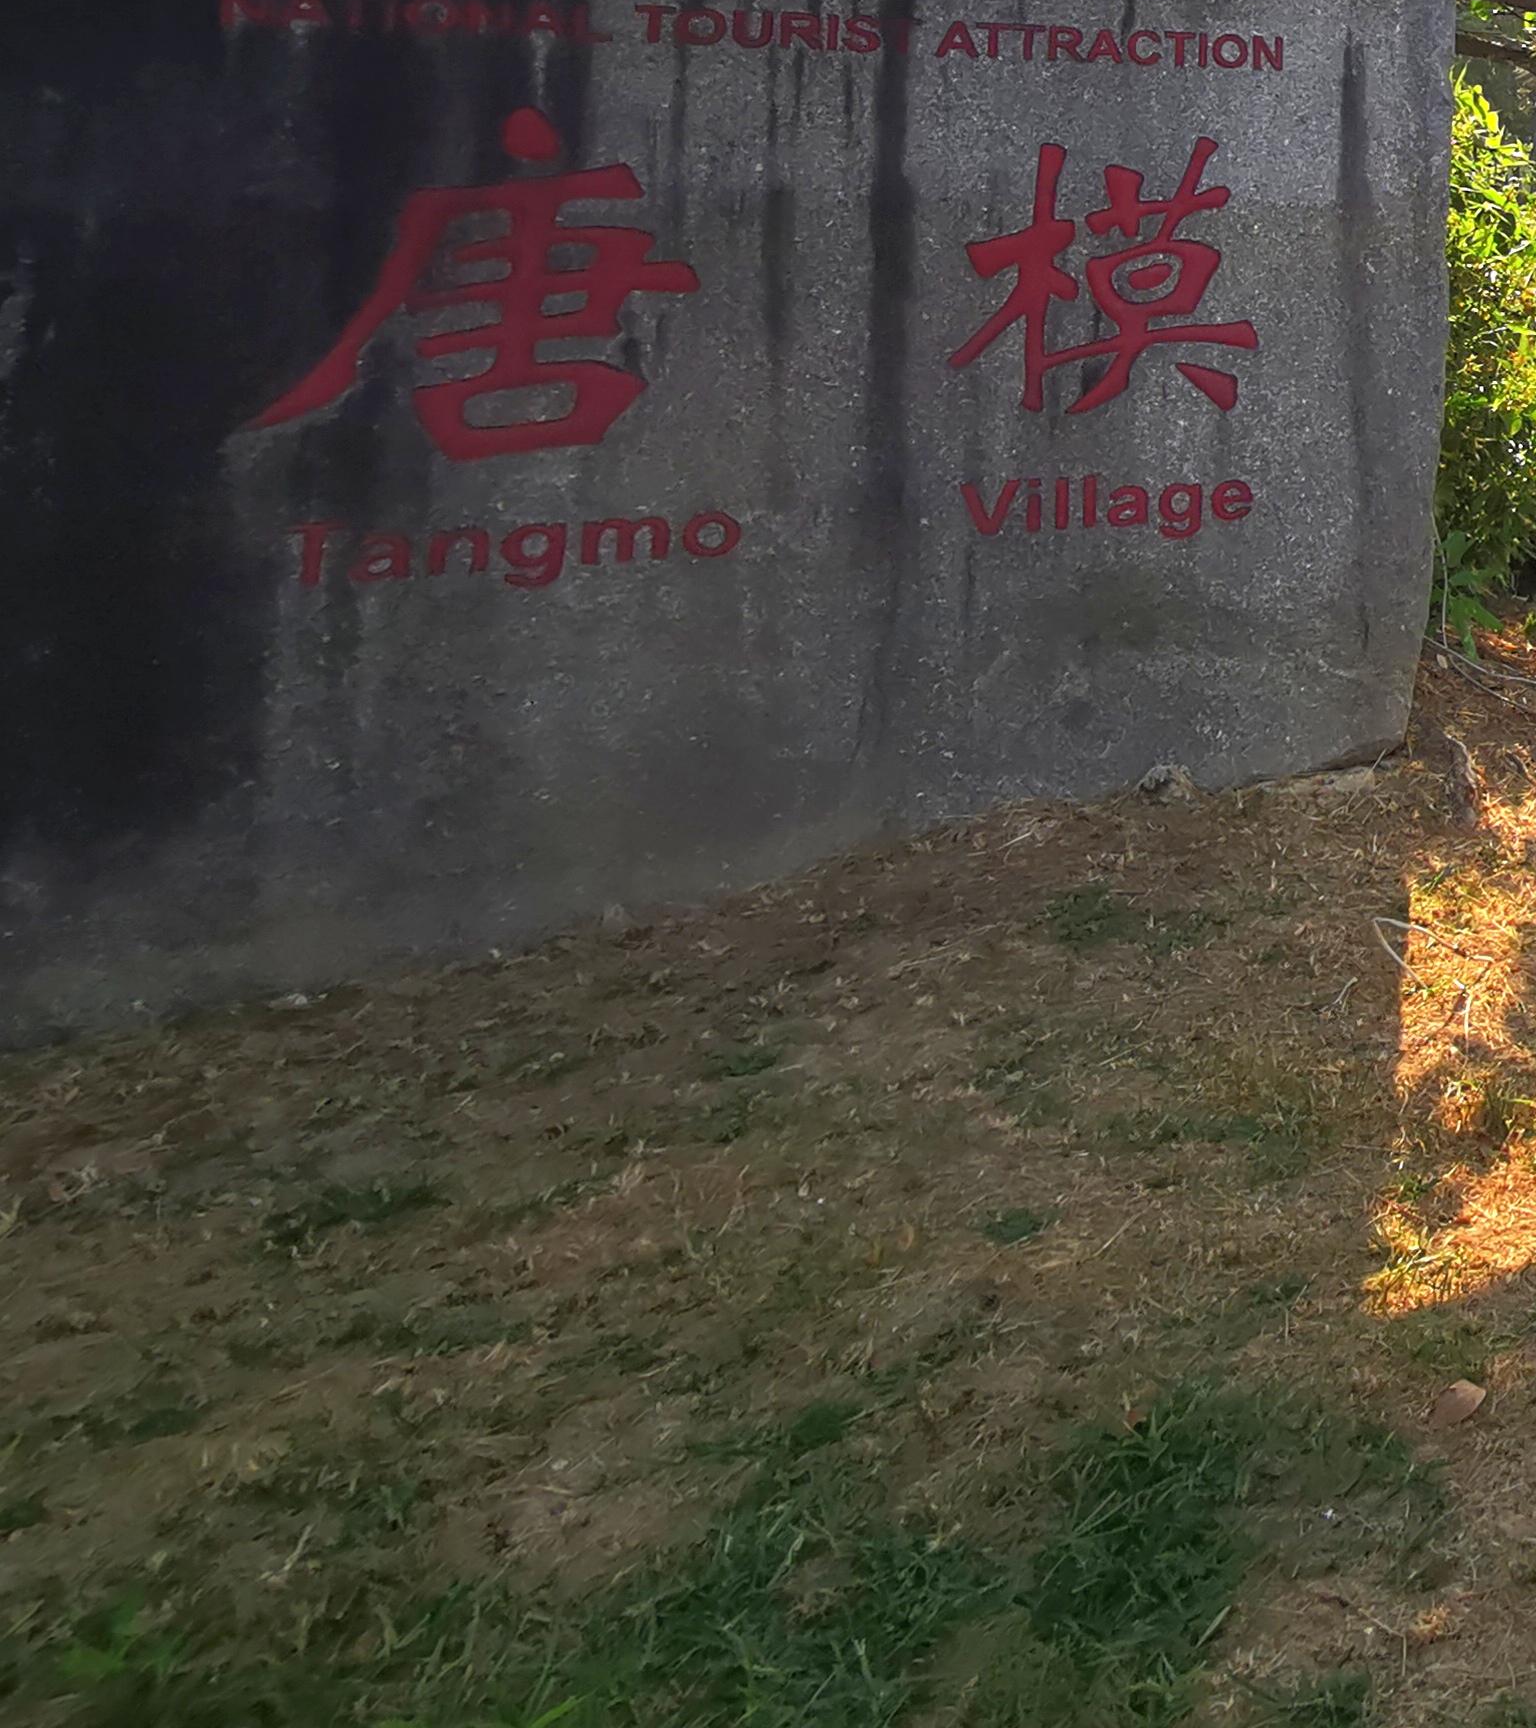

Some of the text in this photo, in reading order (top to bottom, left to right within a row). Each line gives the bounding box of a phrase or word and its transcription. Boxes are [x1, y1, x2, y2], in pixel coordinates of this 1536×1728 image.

[634, 2, 914, 56] TOURIST
[935, 18, 1286, 72] ATTRACTION
[289, 475, 1256, 588] Tangmo Village
